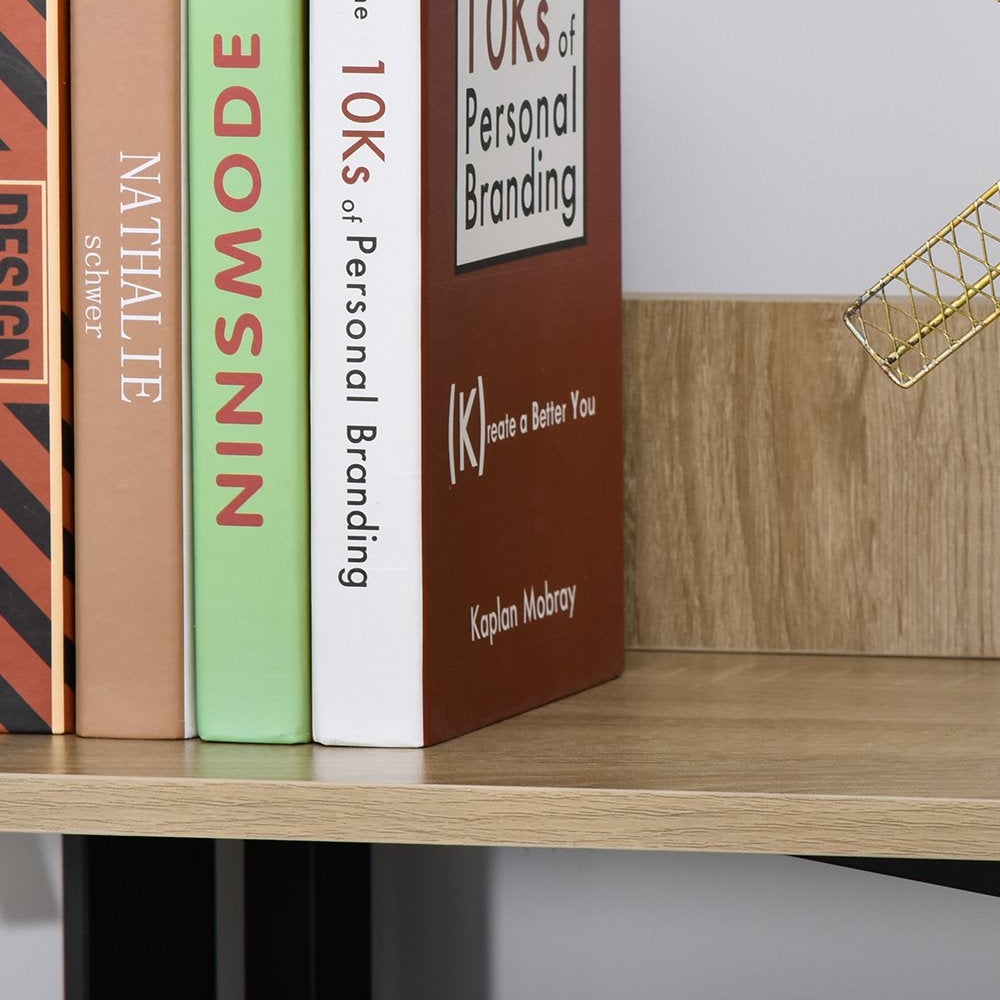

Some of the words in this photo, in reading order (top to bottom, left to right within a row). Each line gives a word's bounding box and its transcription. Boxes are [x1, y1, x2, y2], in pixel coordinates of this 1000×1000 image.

[558, 13, 576, 58] of
[341, 60, 386, 186] 10Ks
[465, 65, 577, 155] Personal
[341, 199, 363, 223] of
[465, 147, 577, 230] Branding
[84, 235, 110, 339] schwer
[119, 151, 163, 404] NATHALIE
[213, 33, 264, 527] NINSMODE
[345, 235, 378, 402] Personal
[448, 375, 516, 485] (K)reate
[520, 413, 528, 435] a
[532, 400, 567, 431] Better
[570, 390, 596, 420] You
[338, 425, 379, 589] Branding
[470, 596, 518, 645] Kaplan
[523, 580, 576, 622] Mobray
